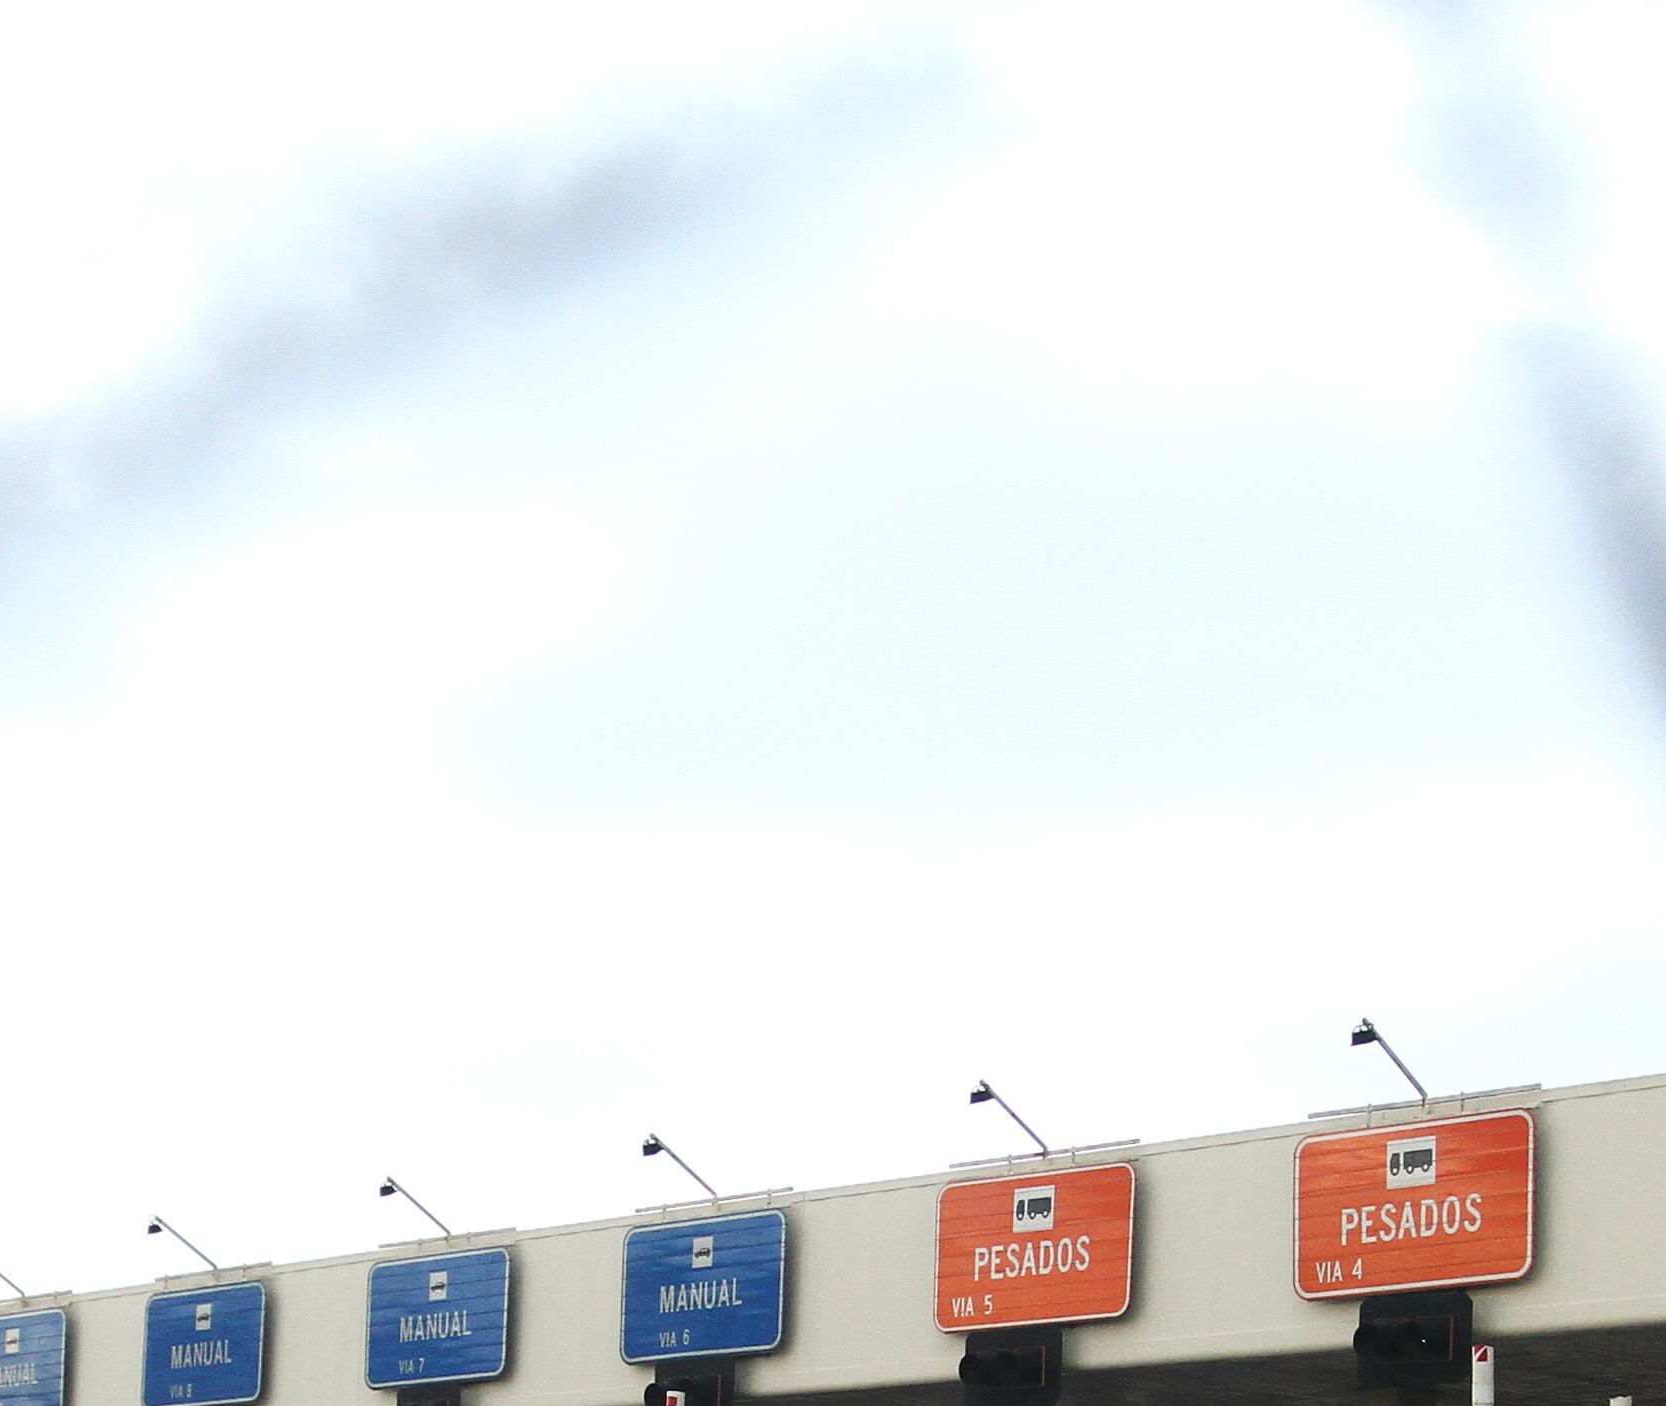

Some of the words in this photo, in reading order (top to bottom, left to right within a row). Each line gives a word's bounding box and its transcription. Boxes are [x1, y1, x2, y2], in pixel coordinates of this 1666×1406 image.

[1341, 1193, 1483, 1246] PESADOS
[974, 1235, 1091, 1281] PESADOS
[1315, 1260, 1344, 1285] VIA
[1351, 1258, 1363, 1280] 4
[659, 1278, 742, 1314] MANUAL
[952, 1297, 976, 1318] VIA
[983, 1295, 993, 1316] 5
[400, 1310, 472, 1343] MANUAL
[659, 1331, 678, 1348] VIA
[682, 1329, 690, 1346] 6
[171, 1339, 232, 1369] MANUAL
[399, 1359, 414, 1375] VIA
[418, 1358, 424, 1373] 7
